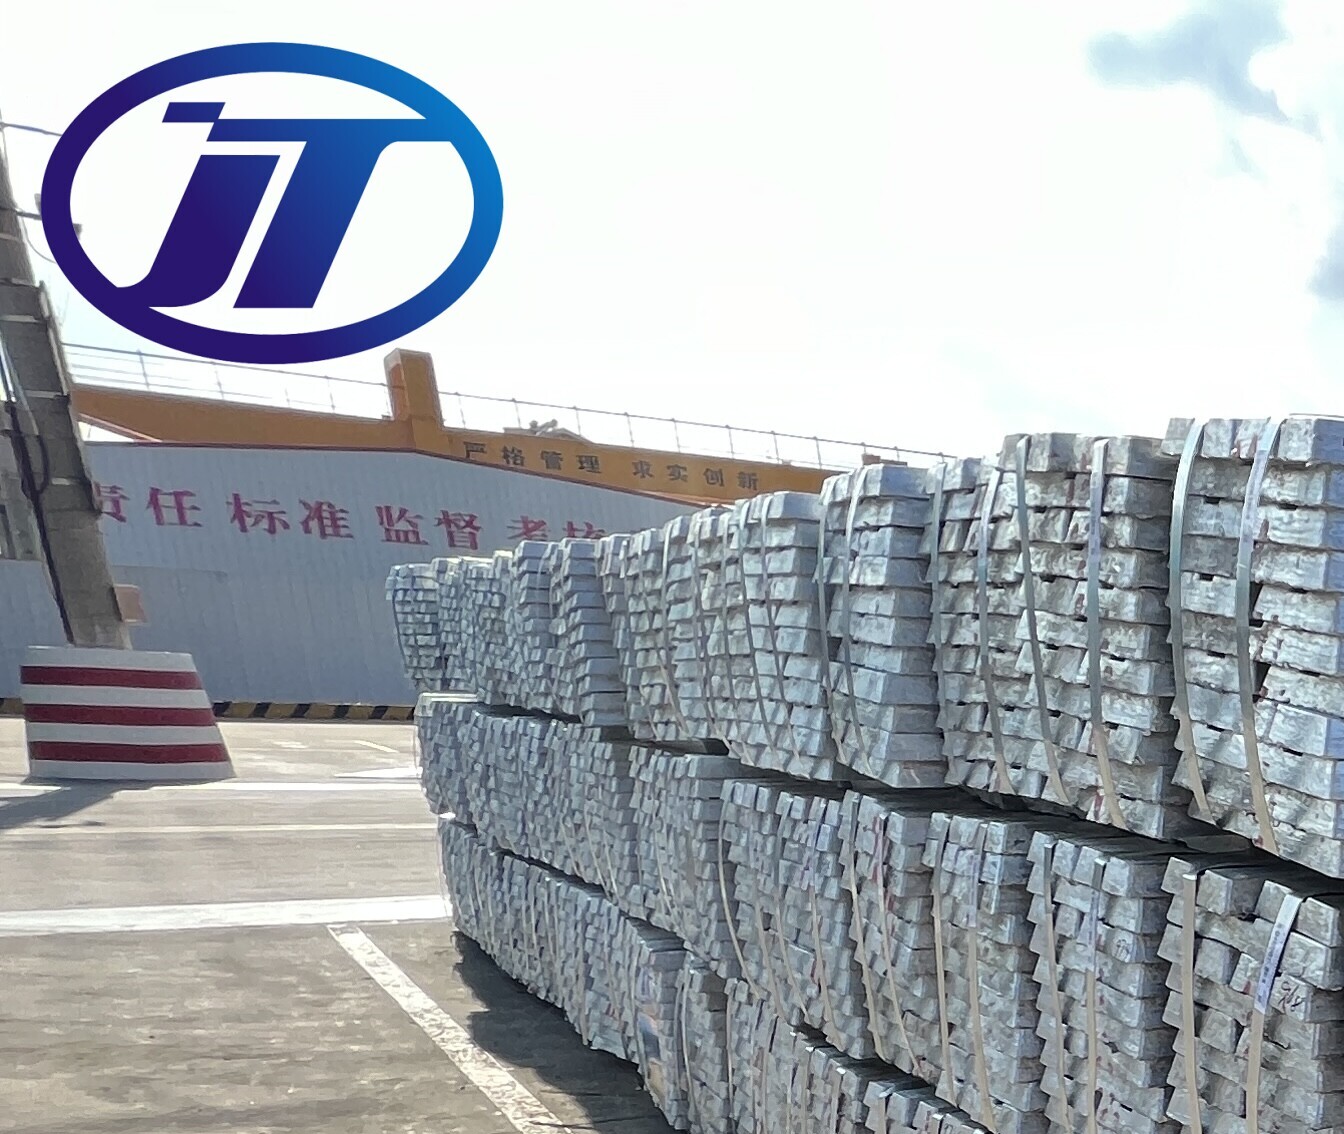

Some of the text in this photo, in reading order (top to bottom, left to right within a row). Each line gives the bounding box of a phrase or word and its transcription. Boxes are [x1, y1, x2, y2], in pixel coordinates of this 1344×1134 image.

[463, 441, 760, 491] 严格管理 求实创新
